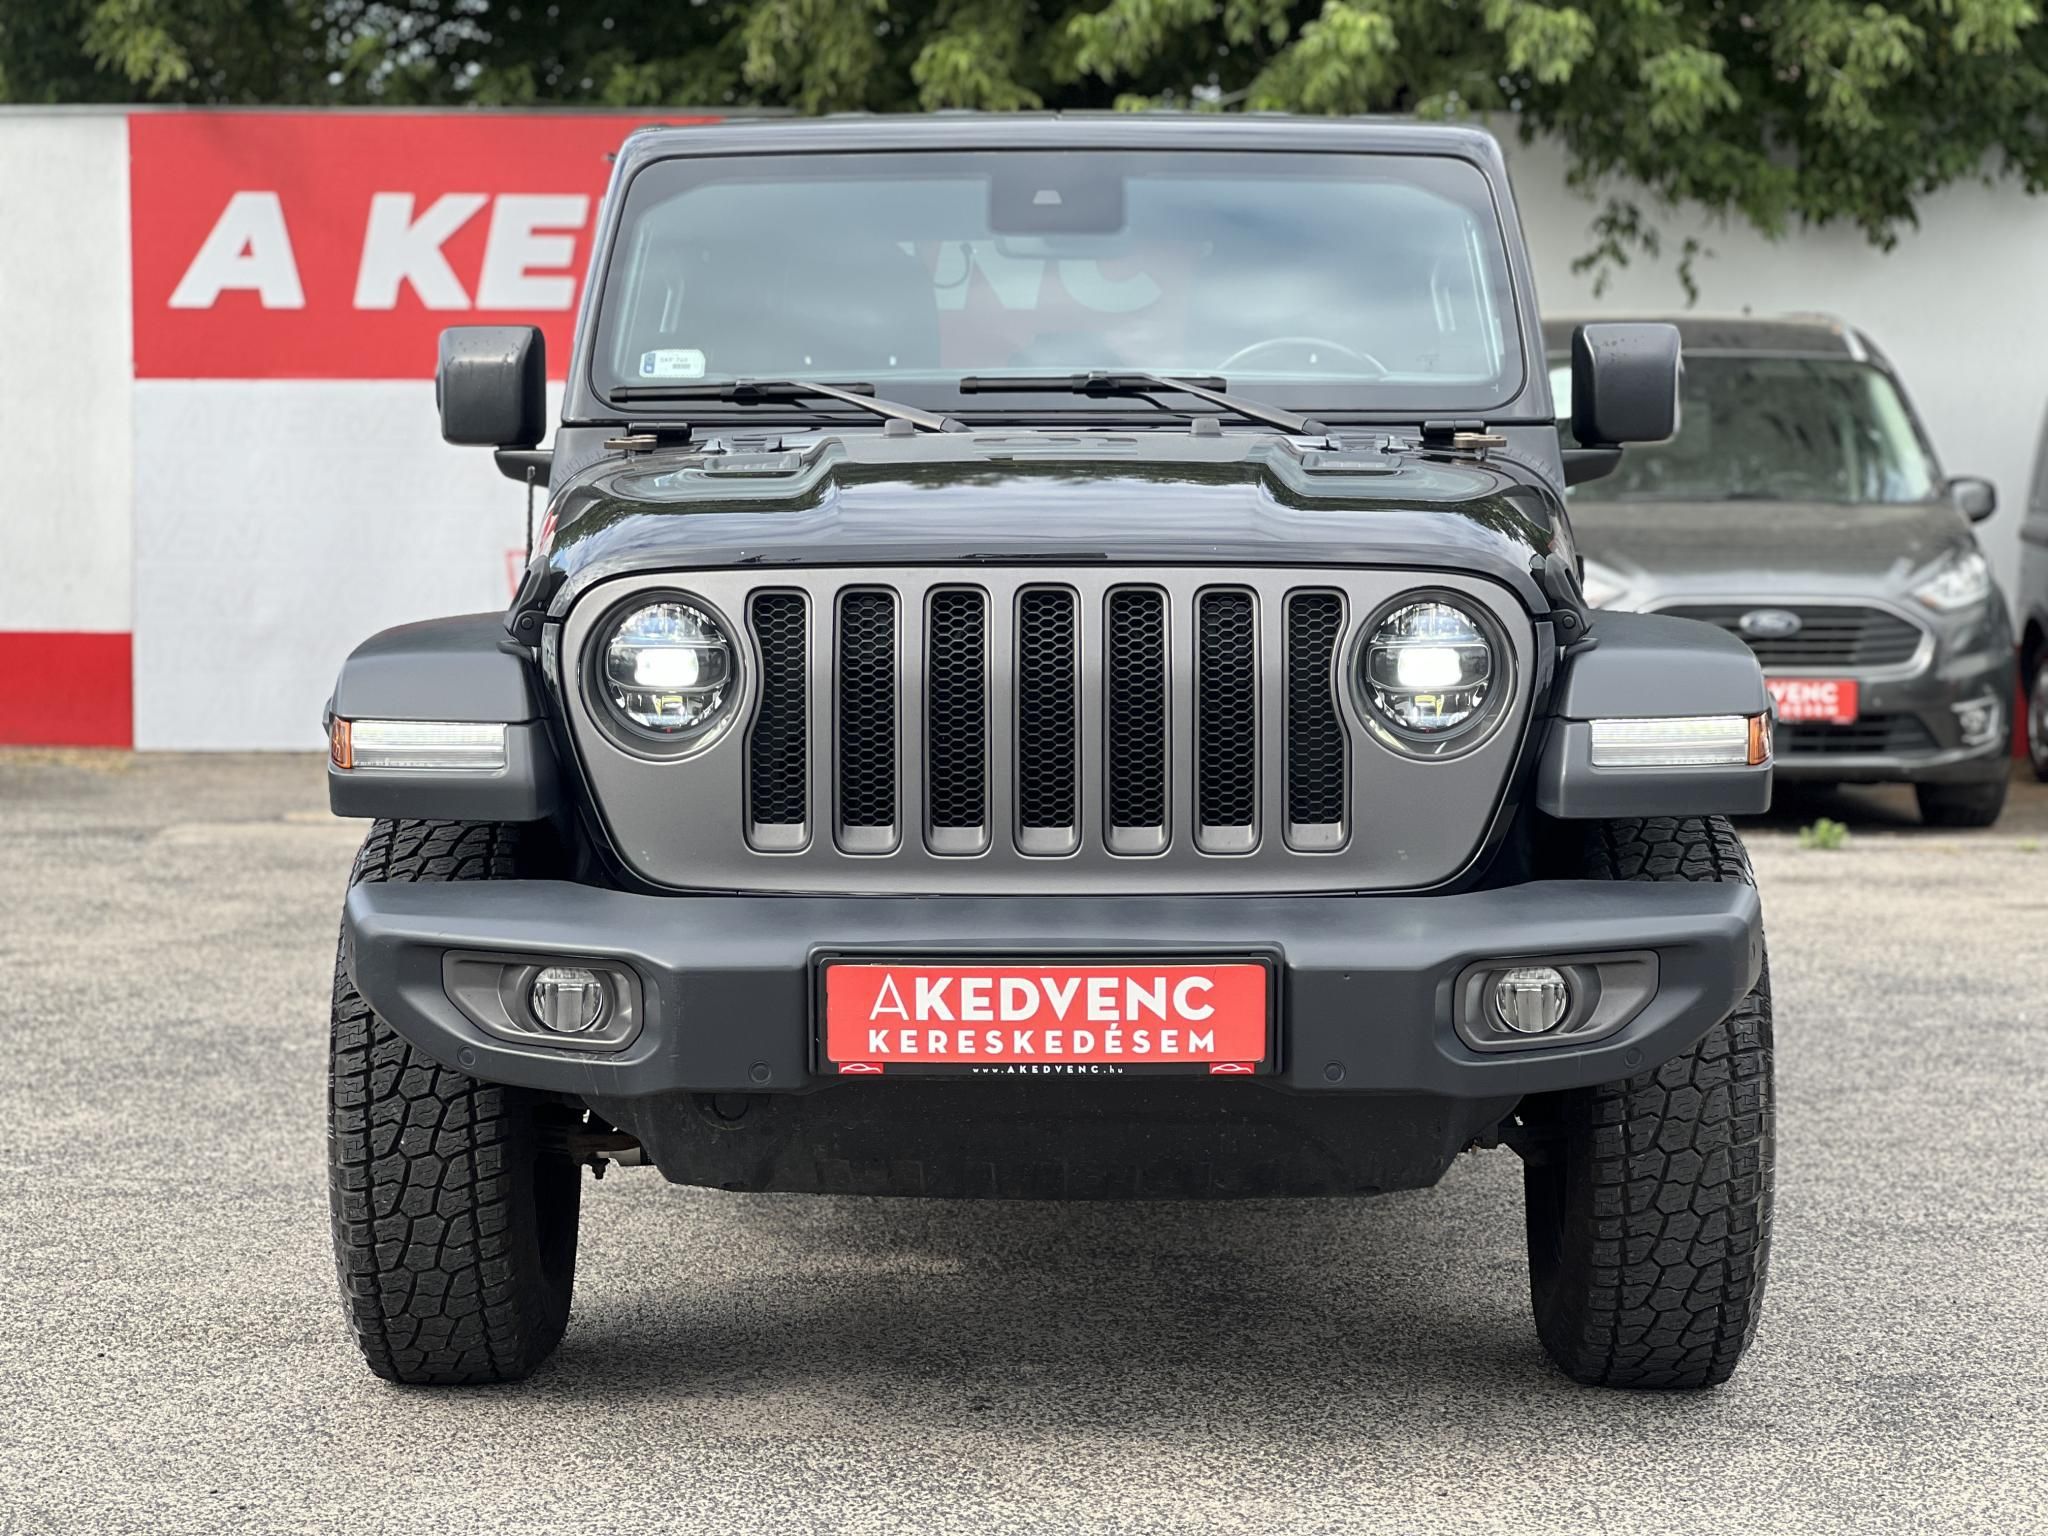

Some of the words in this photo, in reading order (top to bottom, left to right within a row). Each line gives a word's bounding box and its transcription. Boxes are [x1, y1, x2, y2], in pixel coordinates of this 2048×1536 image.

[168, 191, 305, 309] A
[353, 192, 590, 310] KE
[932, 239, 1163, 313] NC
[1766, 681, 1839, 704] VENC
[868, 1023, 1215, 1055] KERESKEDÉSEM
